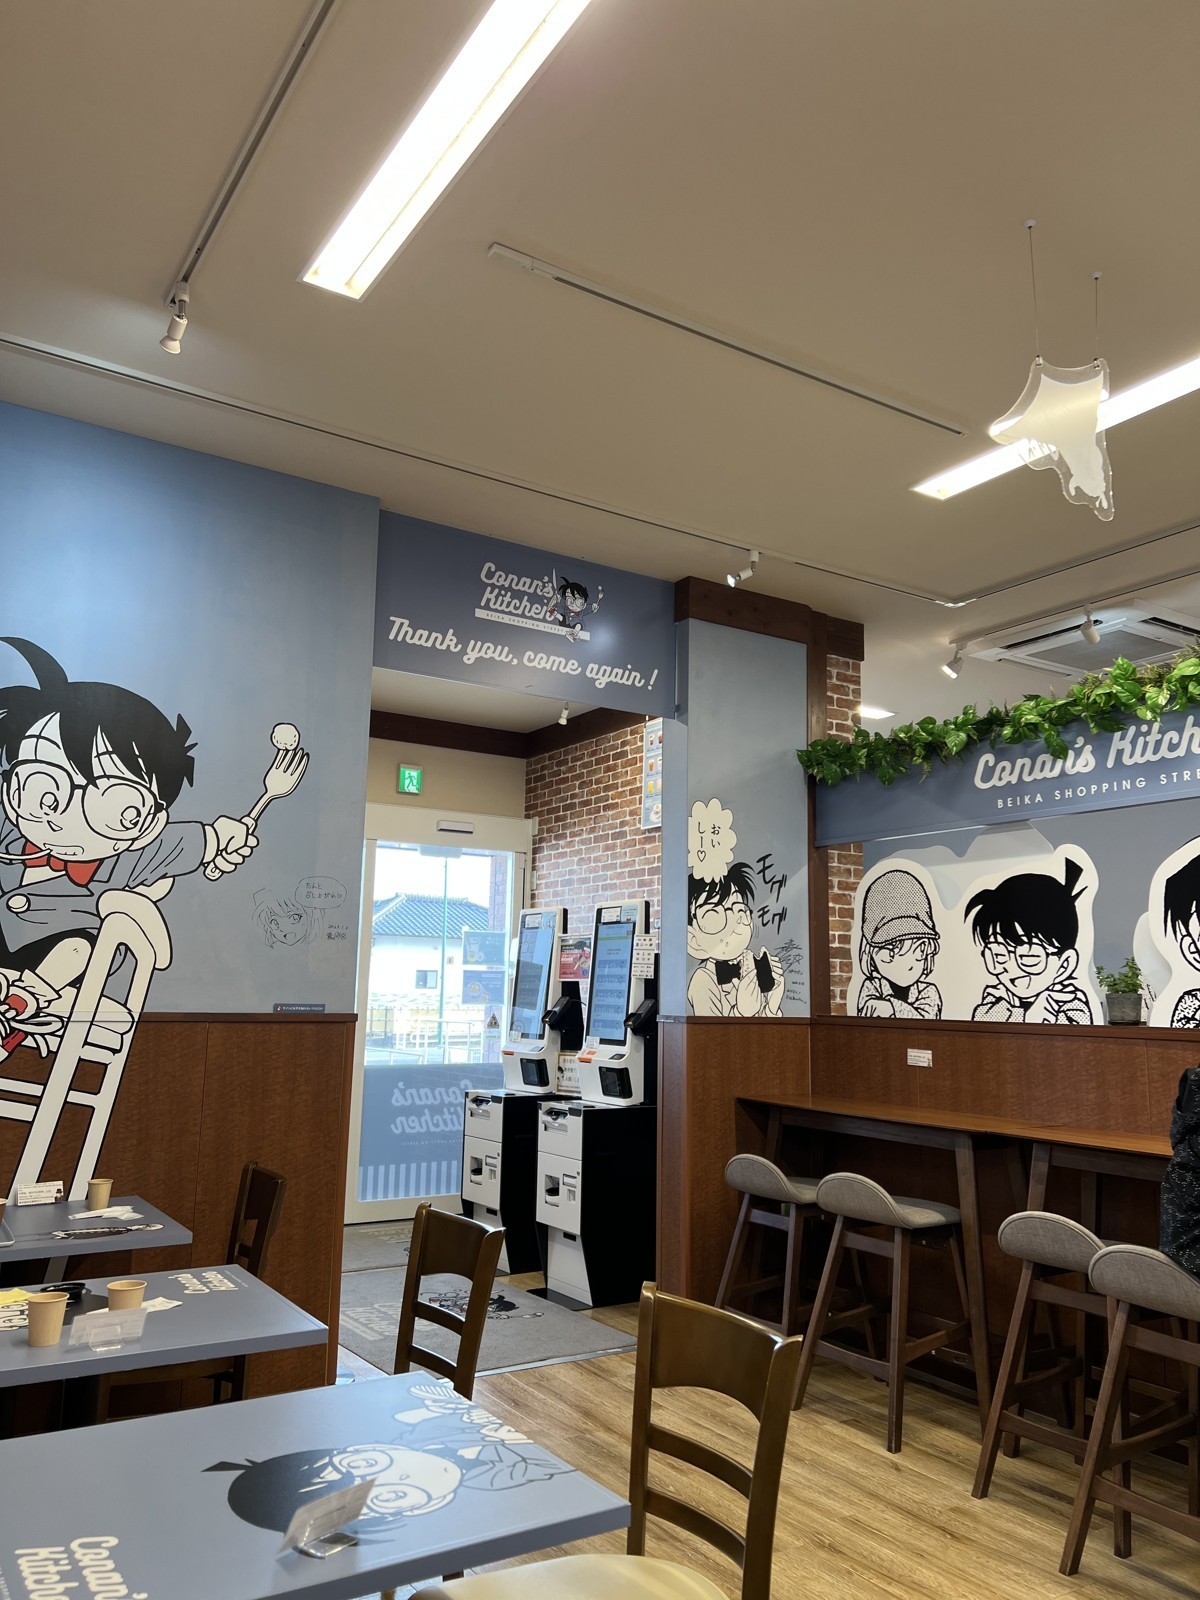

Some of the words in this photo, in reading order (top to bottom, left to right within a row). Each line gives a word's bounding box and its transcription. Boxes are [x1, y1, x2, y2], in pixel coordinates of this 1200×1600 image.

[480, 562, 554, 598] Conan's
[388, 616, 462, 653] Thank
[462, 639, 518, 665] you,
[522, 650, 582, 675] come
[973, 735, 1097, 790] Conan's
[997, 793, 1044, 809] BEIKA
[1054, 777, 1147, 800] SHOPPING
[710, 823, 722, 849] おい
[755, 853, 788, 903] モグ
[756, 904, 788, 935] モグ
